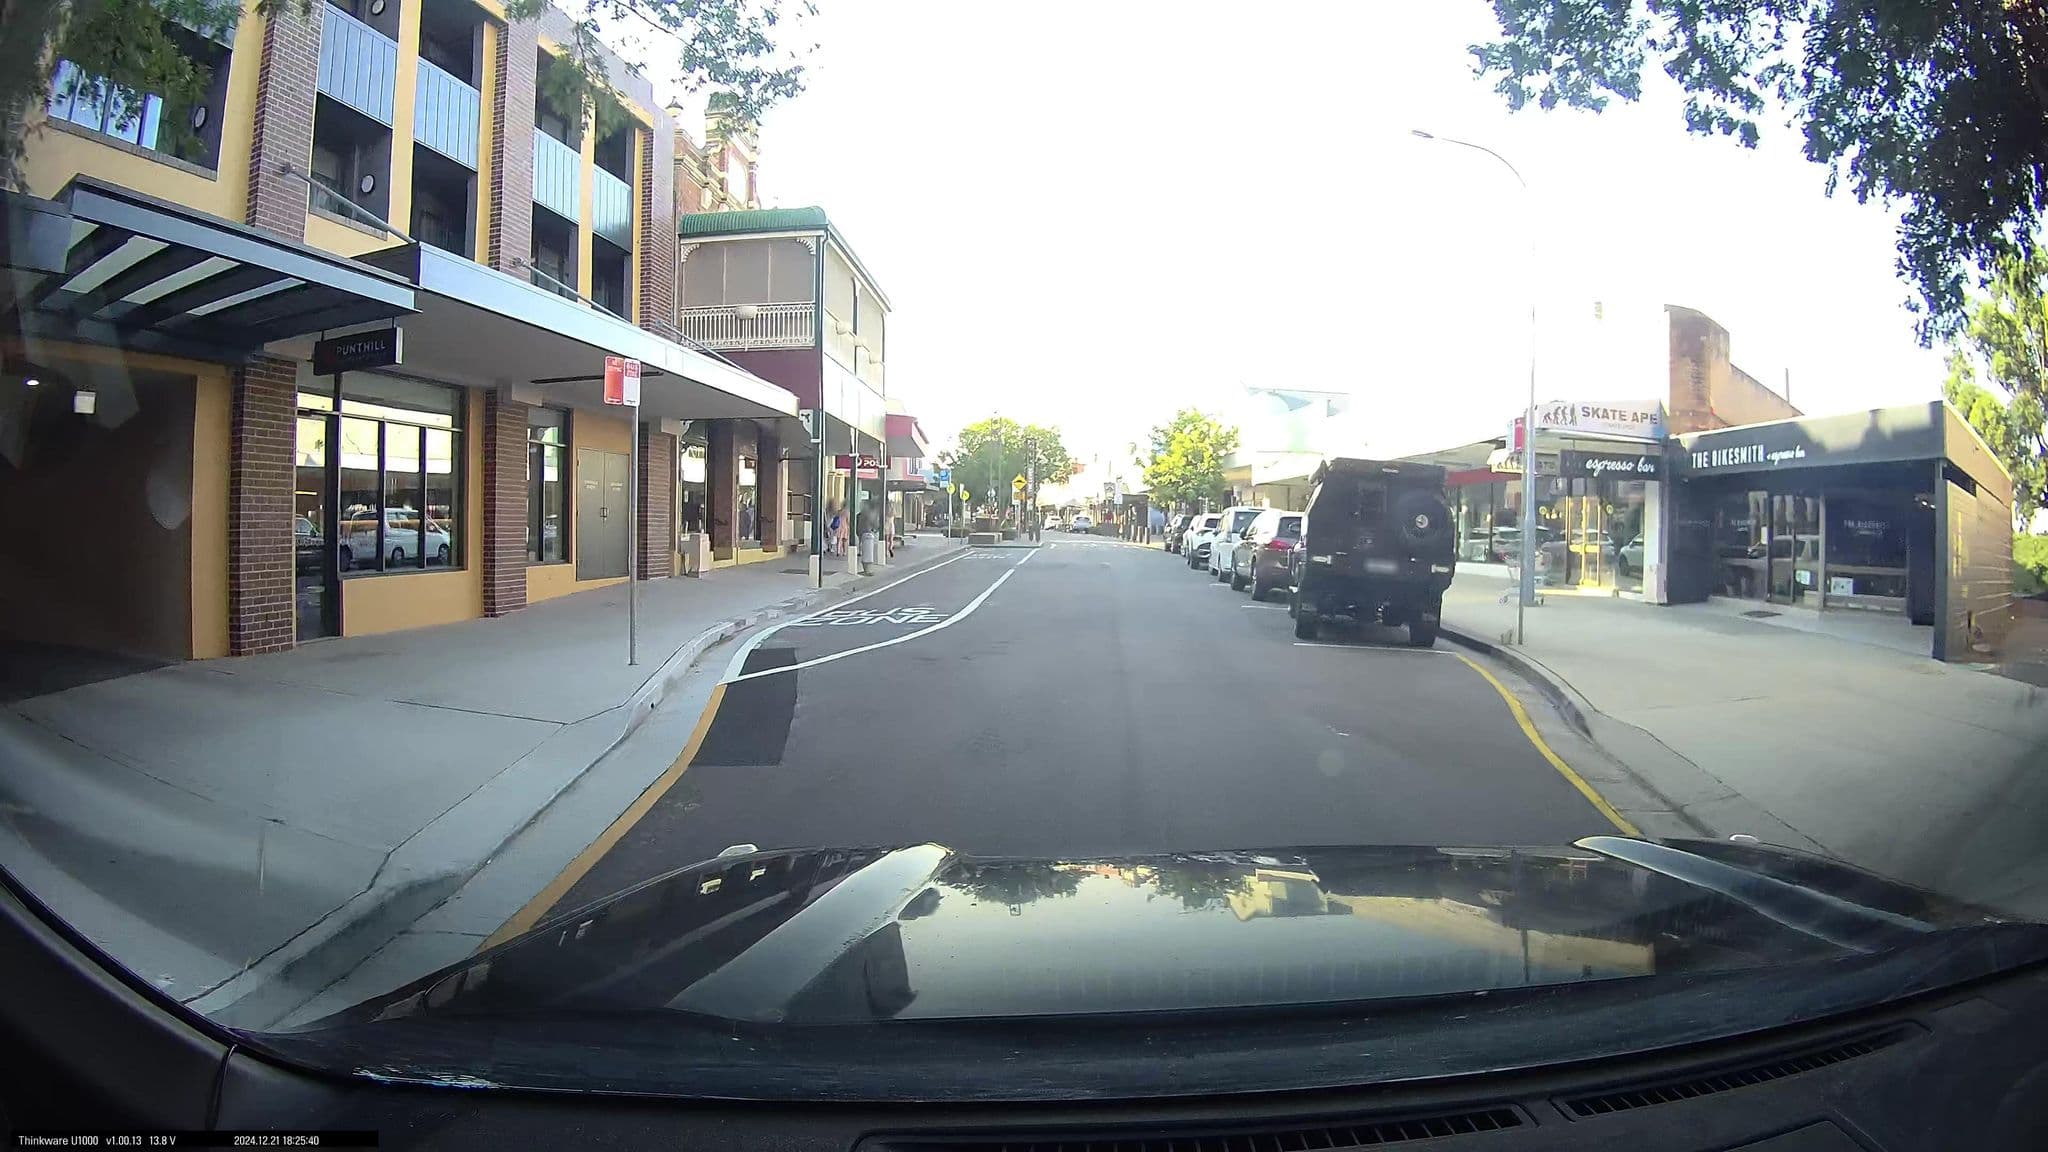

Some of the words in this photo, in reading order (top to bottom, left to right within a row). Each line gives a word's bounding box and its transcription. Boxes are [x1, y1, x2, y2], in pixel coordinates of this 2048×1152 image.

[336, 340, 386, 356] PUNTHILL
[1581, 406, 1627, 421] SKATE
[1632, 411, 1658, 425] APE
[1586, 456, 1634, 477] espresso
[1637, 456, 1655, 473] bar
[1692, 451, 1709, 469] THE
[1712, 444, 1764, 467] BIKESMITH
